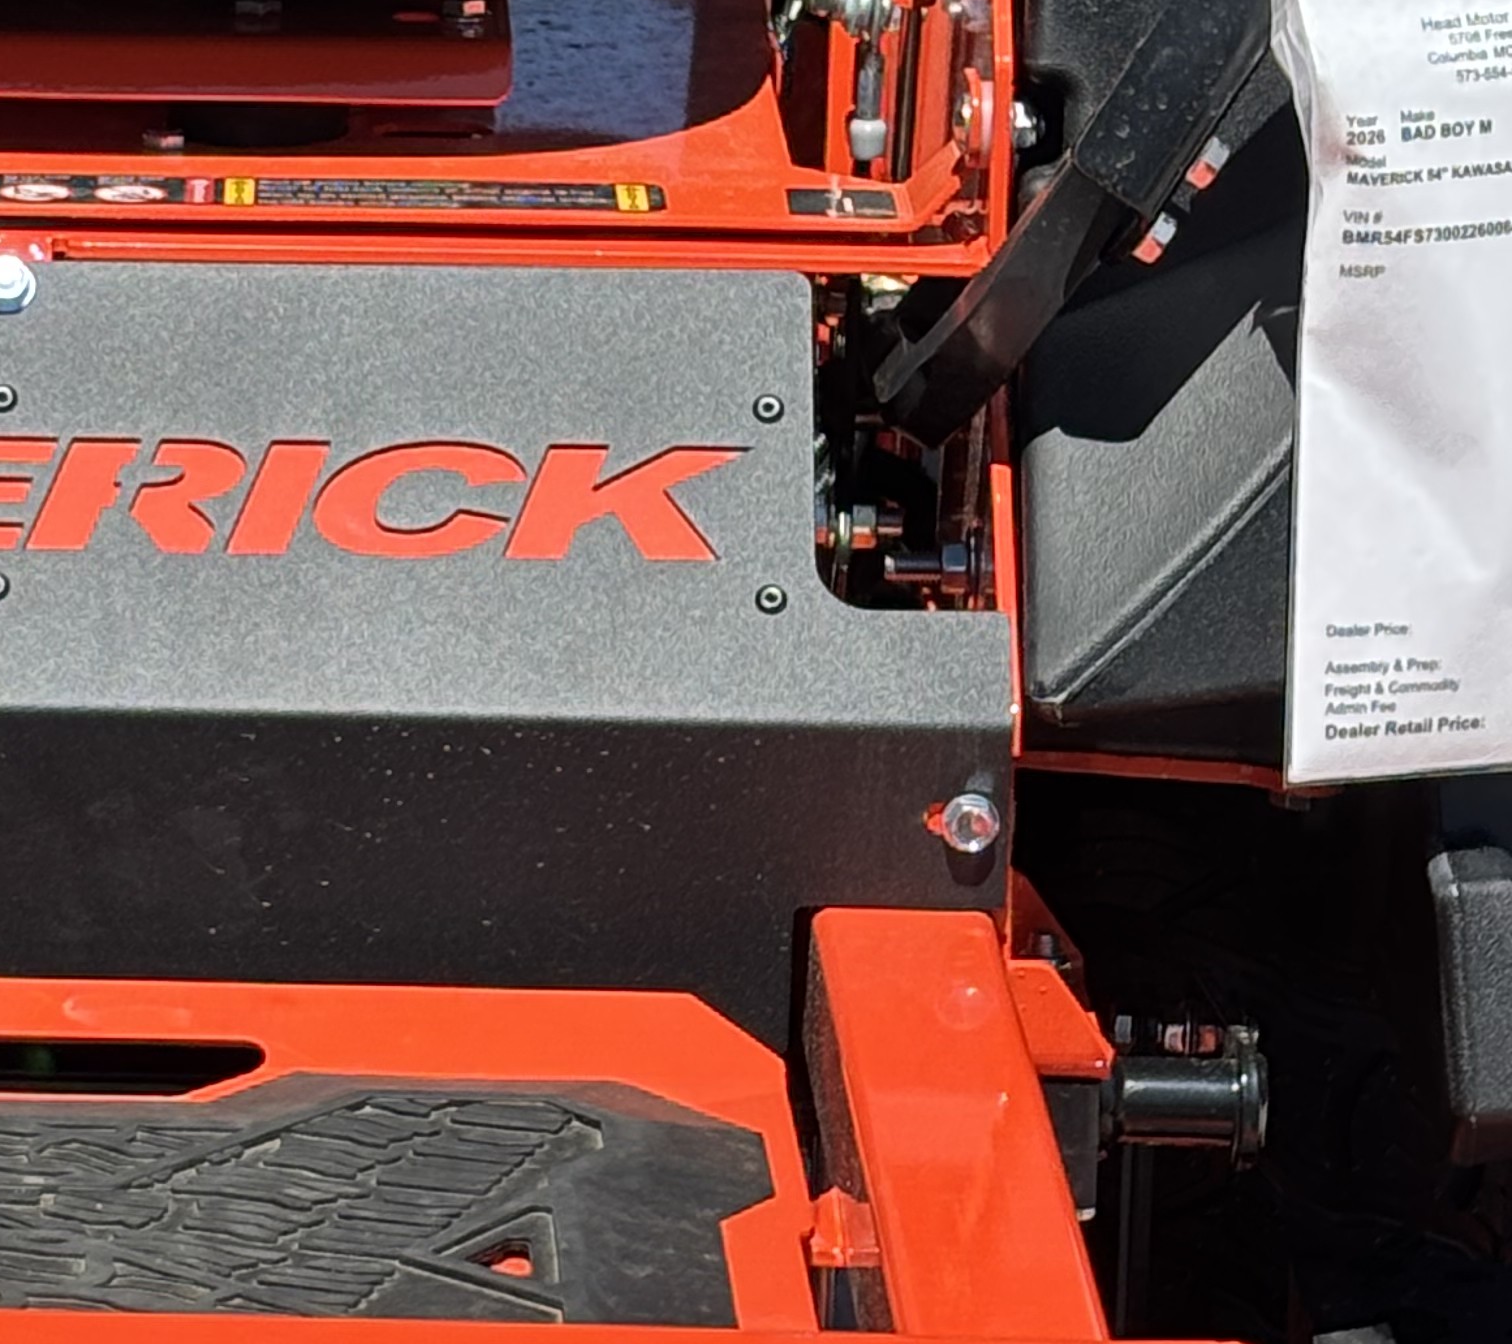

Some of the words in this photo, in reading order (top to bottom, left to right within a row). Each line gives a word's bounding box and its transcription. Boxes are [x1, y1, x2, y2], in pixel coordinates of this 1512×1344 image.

[1420, 16, 1462, 31] Head
[1466, 12, 1509, 26] Motor
[1427, 49, 1488, 65] Columbia
[1346, 115, 1378, 128] Year
[1400, 110, 1436, 124] Make
[1346, 129, 1386, 145] 2026
[1401, 125, 1436, 142] BAD
[1440, 120, 1475, 138] BOY
[1479, 119, 1492, 134] M
[1345, 155, 1387, 169] Model
[1346, 169, 1424, 186] MAVERICK
[1343, 209, 1369, 224] VIN
[1373, 210, 1383, 224] #
[1339, 264, 1386, 278] MSRP
[1326, 623, 1371, 637] Dealer
[1325, 660, 1389, 675] Assembly
[1393, 659, 1403, 672] &
[1325, 683, 1371, 699] Freight
[1374, 681, 1384, 695] &
[1388, 678, 1461, 693] Commodity
[1325, 702, 1368, 716] Admin
[1371, 700, 1397, 713] Fee
[1325, 723, 1381, 740] Dealer
[1385, 717, 1433, 736] Retail
[1437, 716, 1486, 732] Price:
